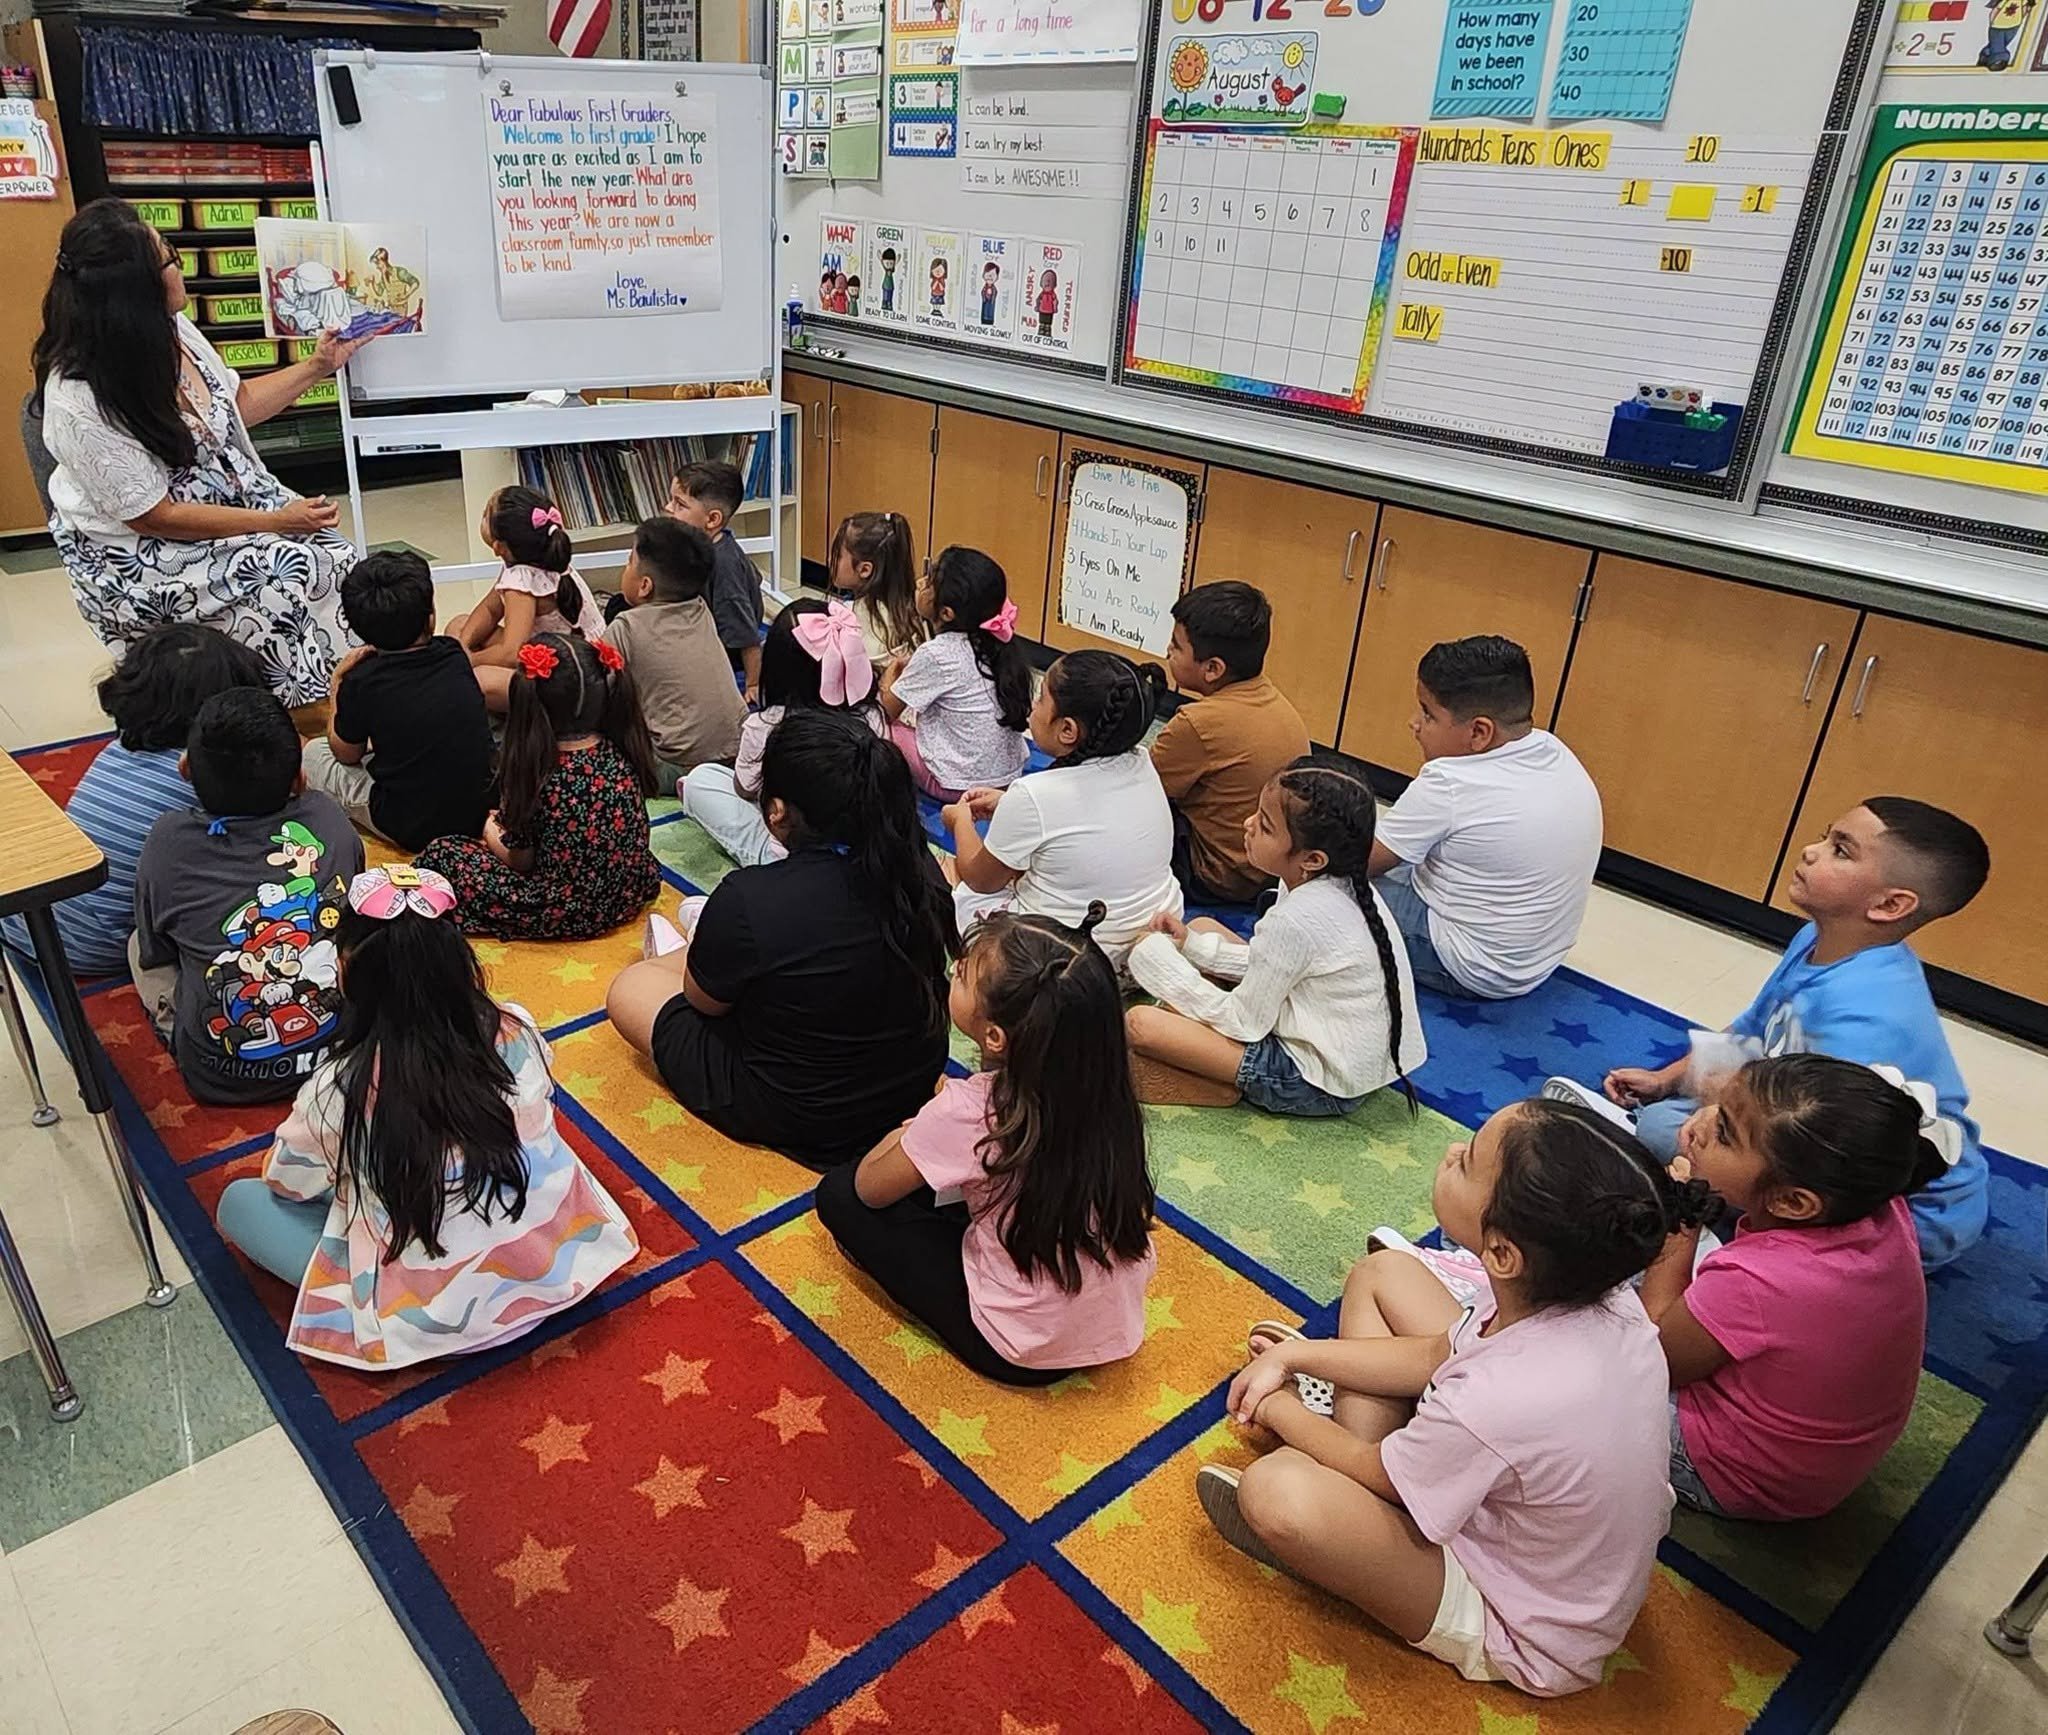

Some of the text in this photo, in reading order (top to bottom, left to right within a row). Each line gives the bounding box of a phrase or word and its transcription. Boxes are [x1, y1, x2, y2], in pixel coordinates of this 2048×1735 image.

[971, 8, 1073, 37] for a long time
[1458, 12, 1540, 28] How many
[1577, 5, 1598, 21] 20
[1456, 32, 1535, 52] days have
[784, 48, 802, 74] M
[1459, 54, 1524, 69] we been
[1568, 46, 1589, 62] 30
[1206, 67, 1271, 98] August
[1451, 74, 1525, 91] in school?
[1560, 85, 1581, 100] 40
[789, 93, 799, 118] P
[899, 85, 907, 105] 3
[490, 99, 524, 122] Dear
[529, 99, 583, 122] Fabulous
[588, 100, 616, 122] First
[966, 98, 973, 116] I
[976, 104, 990, 116] can
[993, 98, 1004, 116] be
[1894, 109, 2048, 130] Numbers
[504, 125, 564, 145] Welcome
[571, 125, 584, 144] to
[589, 124, 615, 144] first
[665, 124, 673, 143] I
[677, 125, 707, 148] hope
[897, 126, 906, 146] 4
[965, 132, 970, 149] I
[975, 140, 990, 150] can
[994, 133, 1006, 153] try
[1010, 140, 1020, 154] my
[493, 146, 702, 172] you are as excited as I am to
[785, 134, 796, 162] S
[1420, 129, 1492, 162] Hundreds
[1500, 134, 1537, 166] Tens
[1553, 134, 1601, 168] Ones
[498, 170, 532, 188] start
[542, 169, 562, 188] the
[571, 173, 596, 187] new
[635, 166, 666, 186] What
[672, 171, 693, 186] are
[967, 167, 972, 183] I
[975, 174, 989, 183] can
[995, 167, 1005, 184] be
[1372, 168, 1376, 186] 1
[1902, 169, 2046, 185] 1 2 3 4 5 6
[498, 188, 696, 216] you looking forward to doing
[1159, 193, 1371, 232] 2 3 4 5 6 7 8
[509, 210, 675, 233] this year? We are now a
[502, 233, 563, 252] classroom
[628, 230, 651, 255] just
[657, 227, 714, 247] remember
[826, 224, 856, 244] WHAT
[876, 227, 904, 242] GREEN
[1154, 230, 1226, 253] 9 10 11
[982, 240, 1005, 254] BLUE
[1043, 246, 1062, 261] RED
[226, 252, 256, 270] Edgar
[505, 256, 517, 274] to
[522, 256, 536, 273] be
[822, 253, 842, 272] AM
[1407, 252, 1492, 286] Odd or Even
[630, 288, 678, 308] Bautista
[1401, 304, 1440, 340] Tally
[1092, 465, 1160, 493] Give Me Five
[1073, 489, 1178, 530] 5 Criss Cross Applesauce
[1072, 519, 1168, 563] 4 Hands In Your Lap
[1067, 547, 1076, 564] 3
[1080, 550, 1100, 575] Eyes
[1107, 559, 1120, 577] On
[1065, 575, 1160, 624] 2 You Are Ready
[1076, 608, 1083, 625] I
[1090, 613, 1106, 632] Am
[1112, 620, 1144, 650] Ready
